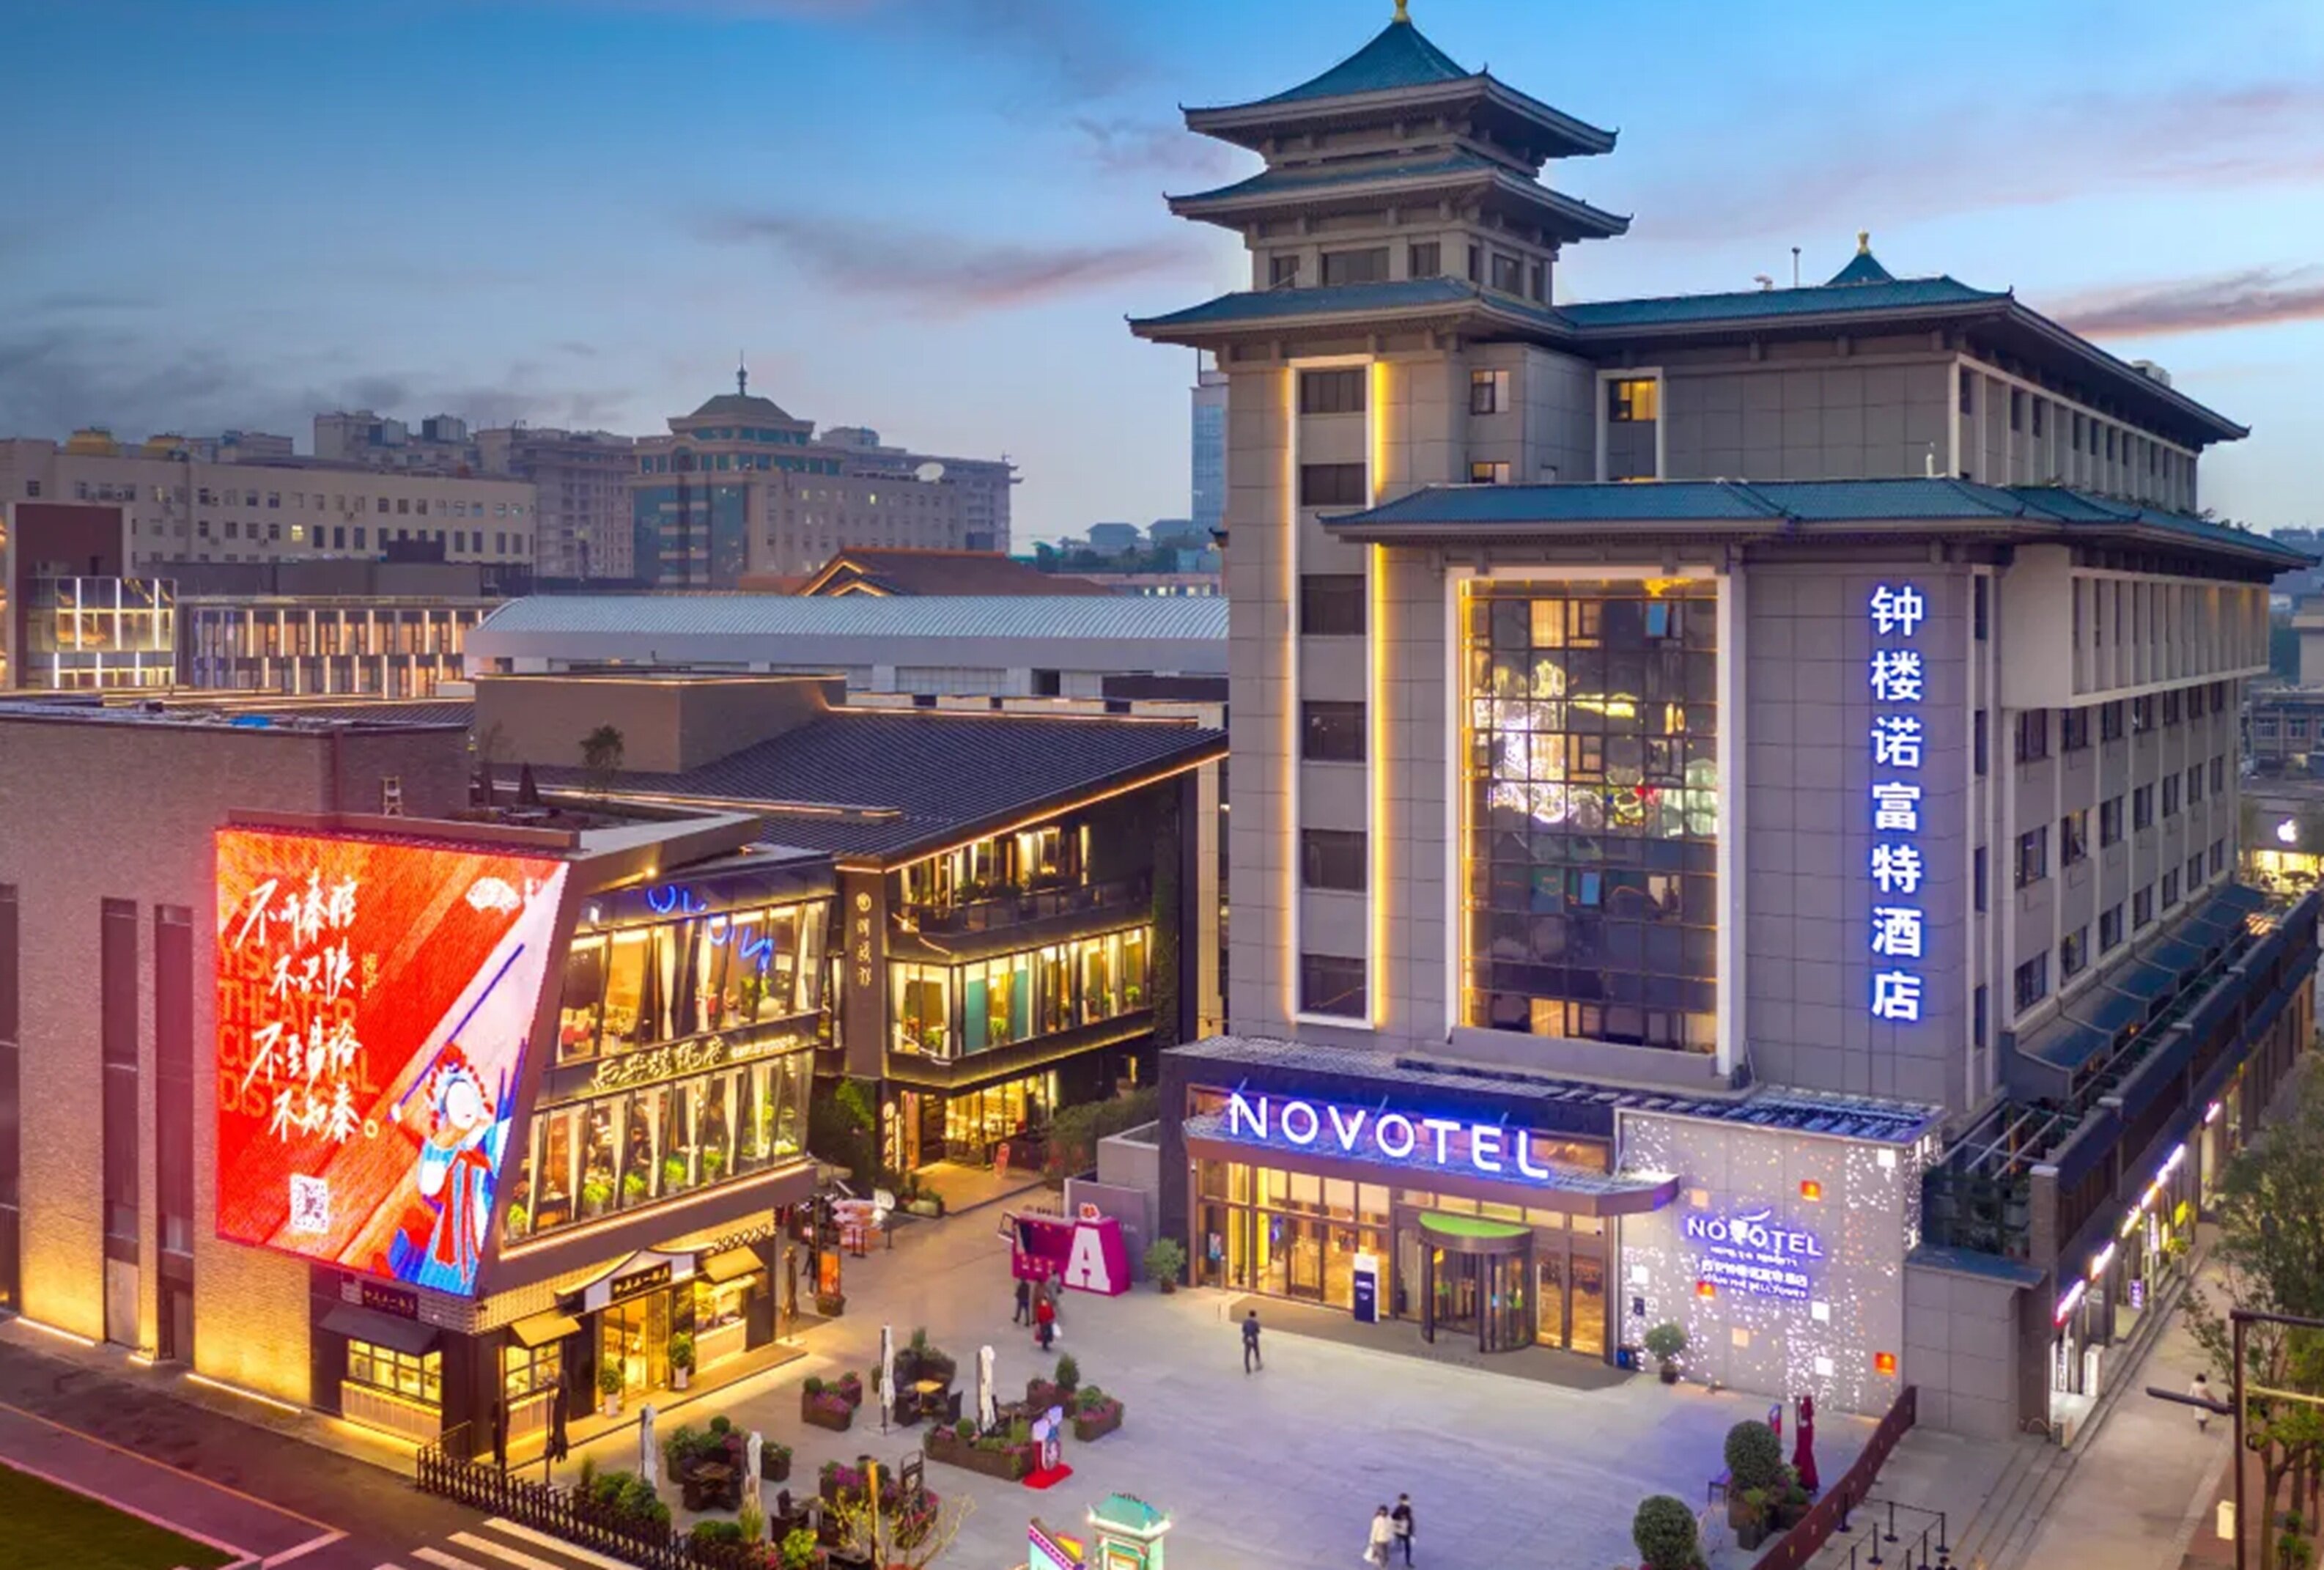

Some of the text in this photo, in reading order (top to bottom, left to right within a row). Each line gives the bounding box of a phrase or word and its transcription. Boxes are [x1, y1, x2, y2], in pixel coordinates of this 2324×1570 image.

[1870, 586, 1923, 1021] 钟楼诺富特酒店
[1229, 1092, 1549, 1179] NOVOTEL
